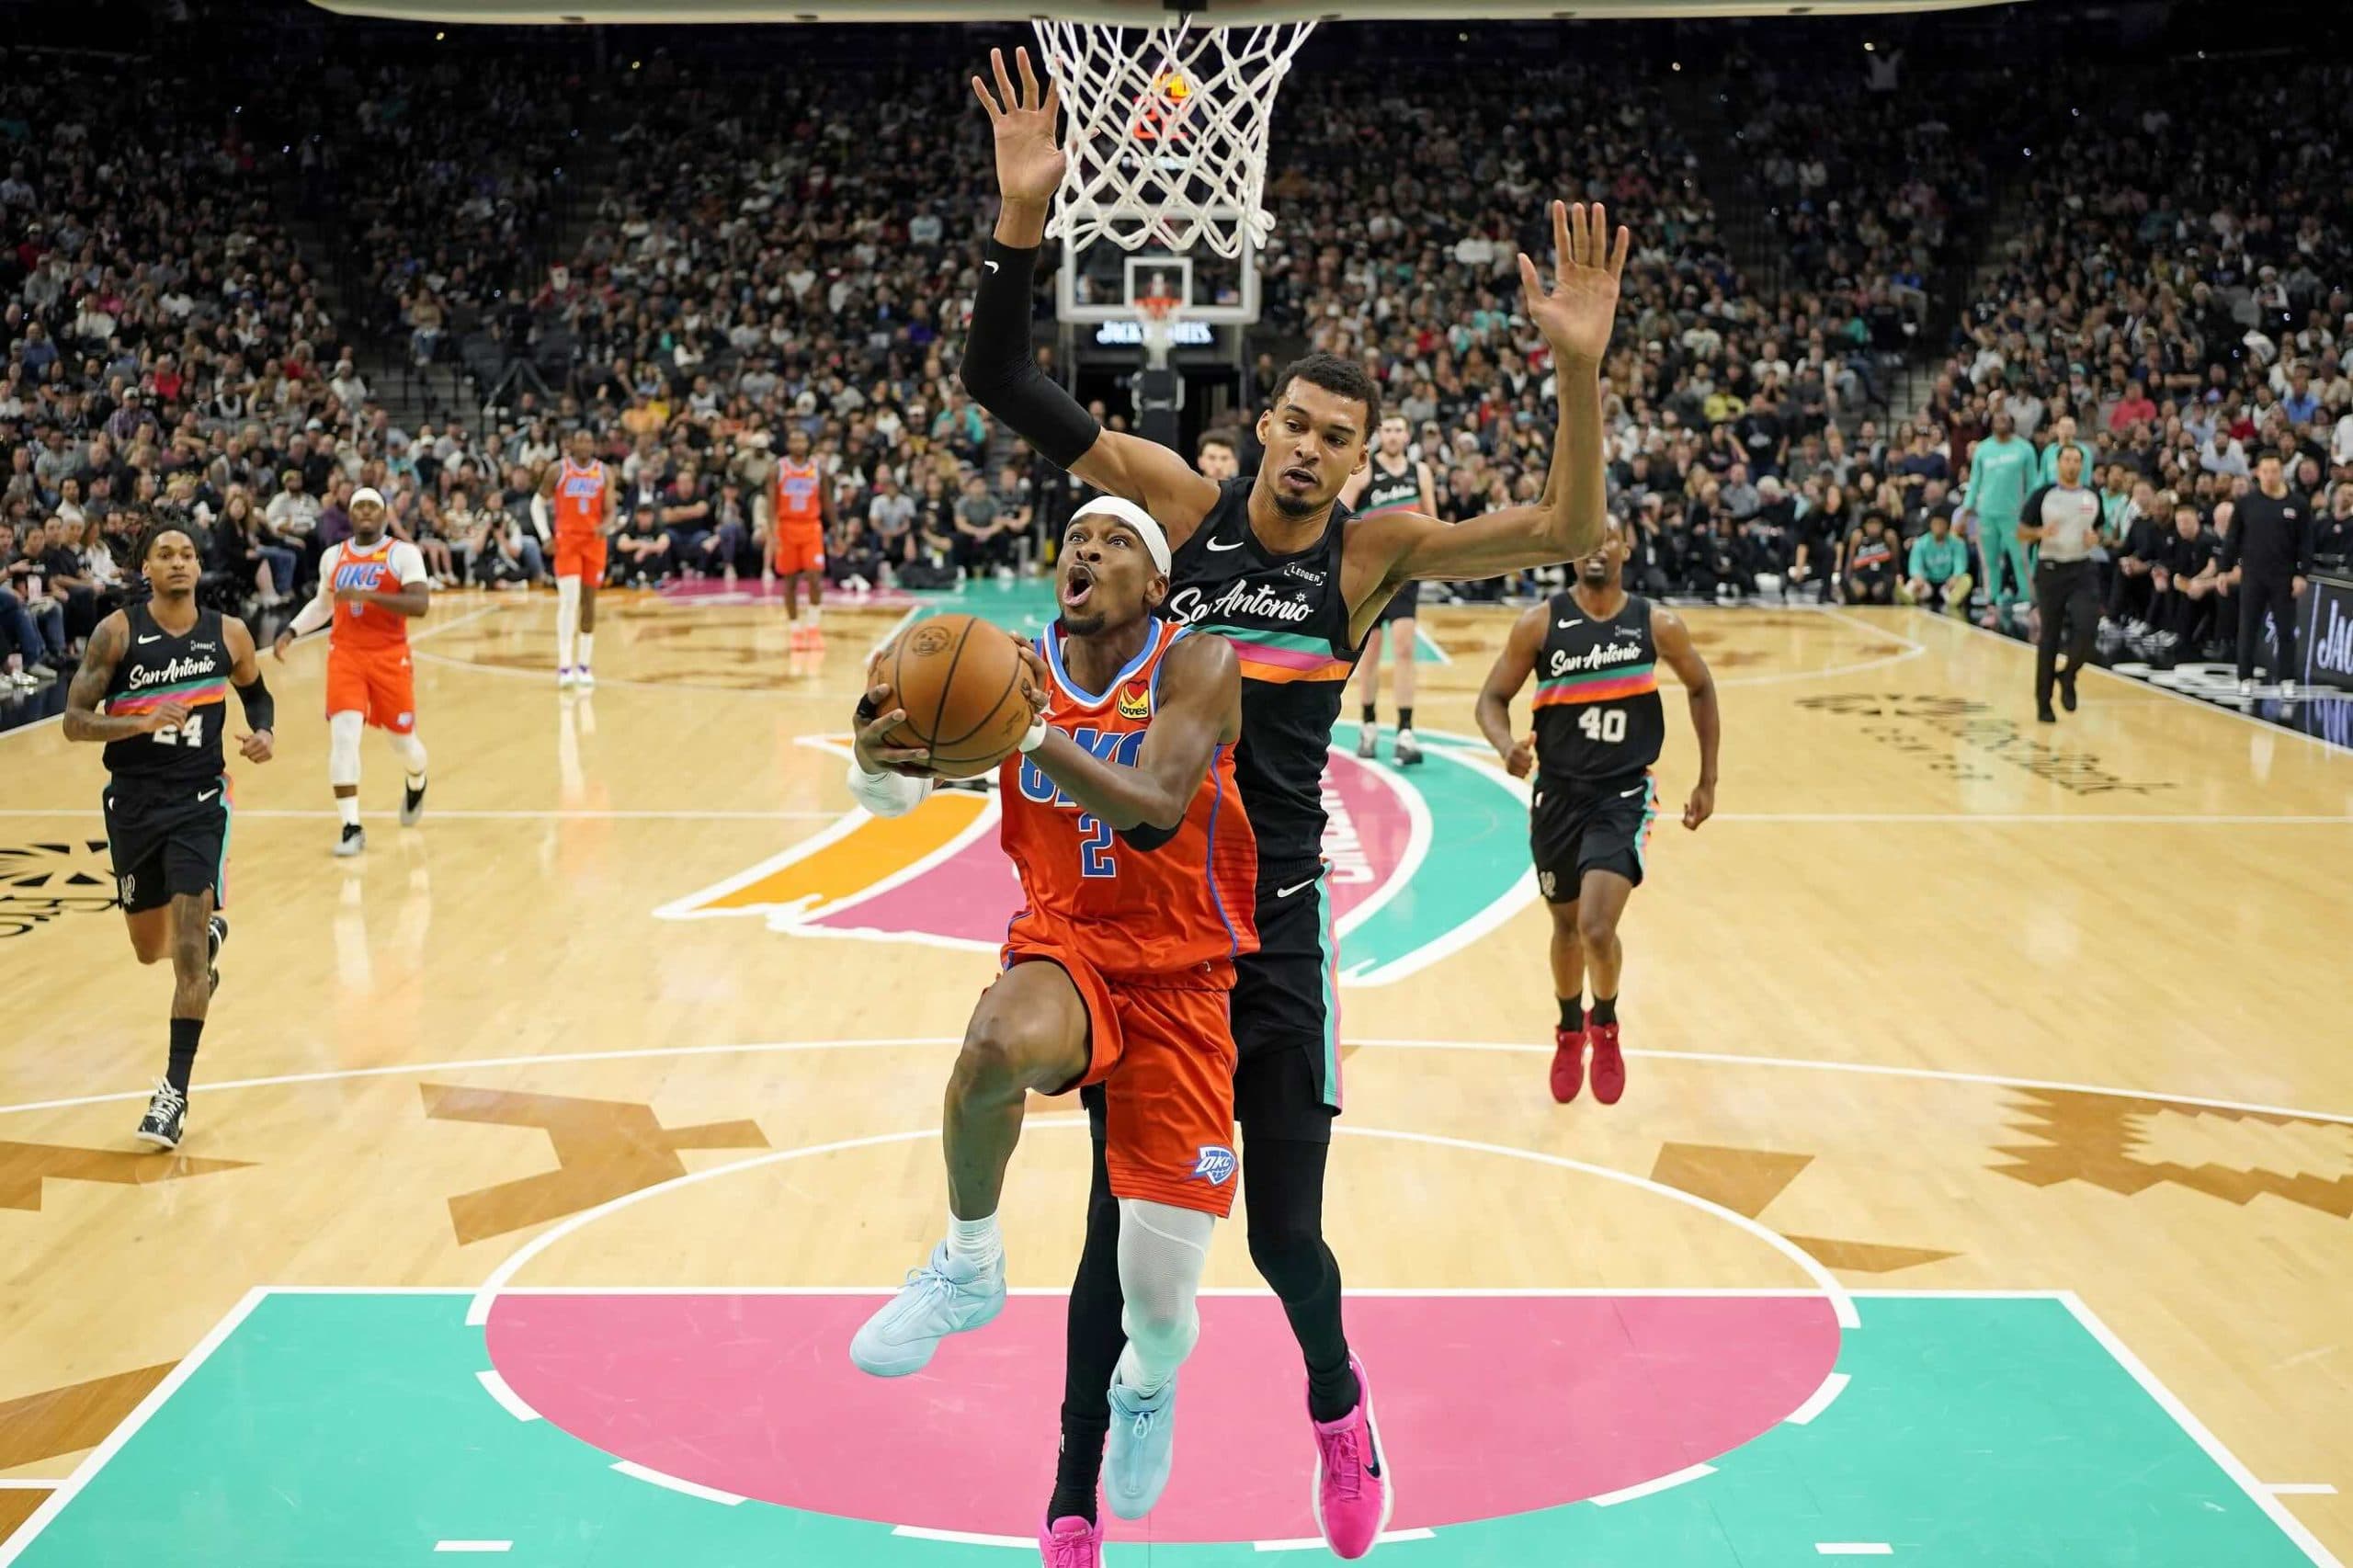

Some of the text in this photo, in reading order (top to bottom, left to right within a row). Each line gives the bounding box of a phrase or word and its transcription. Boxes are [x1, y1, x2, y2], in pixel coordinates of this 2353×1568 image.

[335, 562, 386, 590] OKC
[1290, 563, 1321, 584] LEDGER
[1212, 579, 1314, 622] Antonio
[129, 654, 216, 690] San Antonio
[1551, 642, 1642, 676] San Antonio
[1578, 706, 1627, 743] 40
[1078, 812, 1116, 877] 2
[1195, 1155, 1232, 1173] OKC
